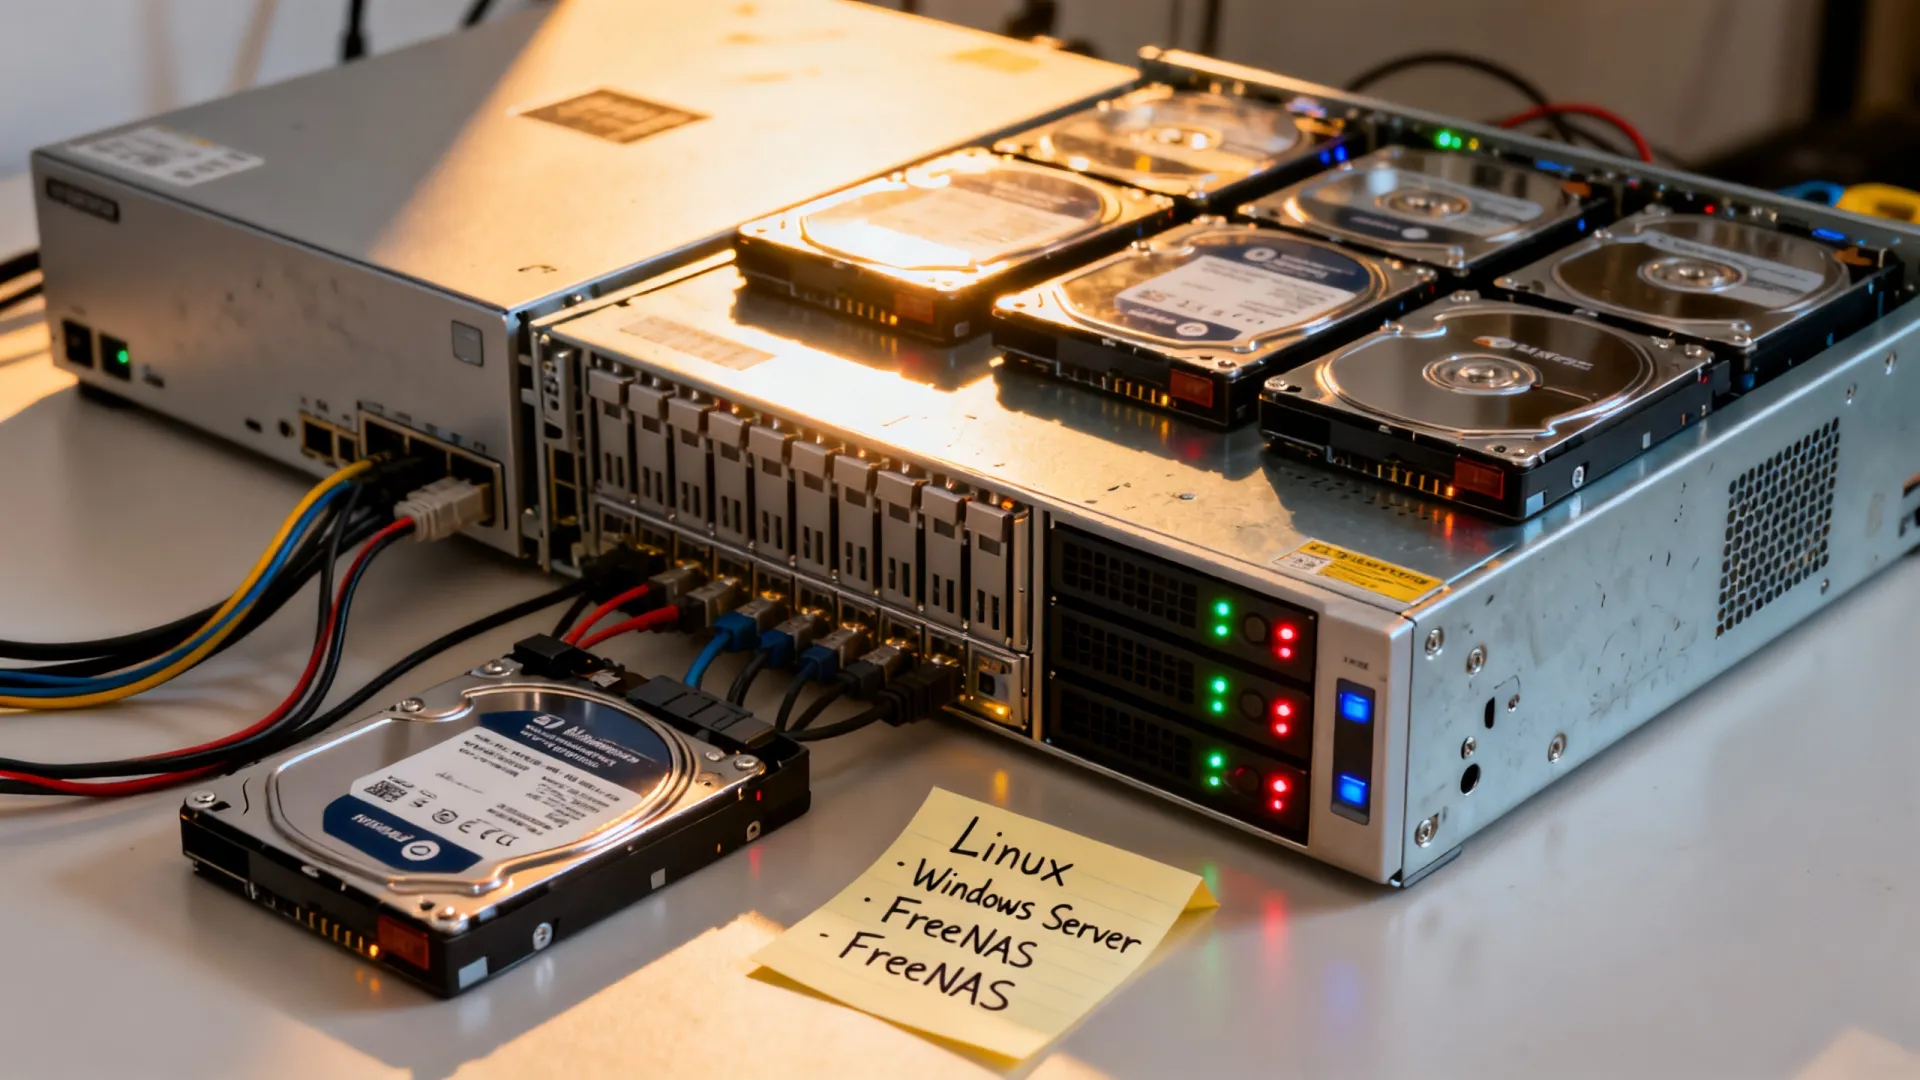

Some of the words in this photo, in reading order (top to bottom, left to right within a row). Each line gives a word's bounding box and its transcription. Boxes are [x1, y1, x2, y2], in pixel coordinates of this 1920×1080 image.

[949, 815, 1074, 887] Linux
[881, 895, 1038, 969] FreeNAS
[913, 857, 1035, 921] Windows
[1042, 903, 1142, 954] Server
[839, 931, 1016, 1012] FreeNAS
